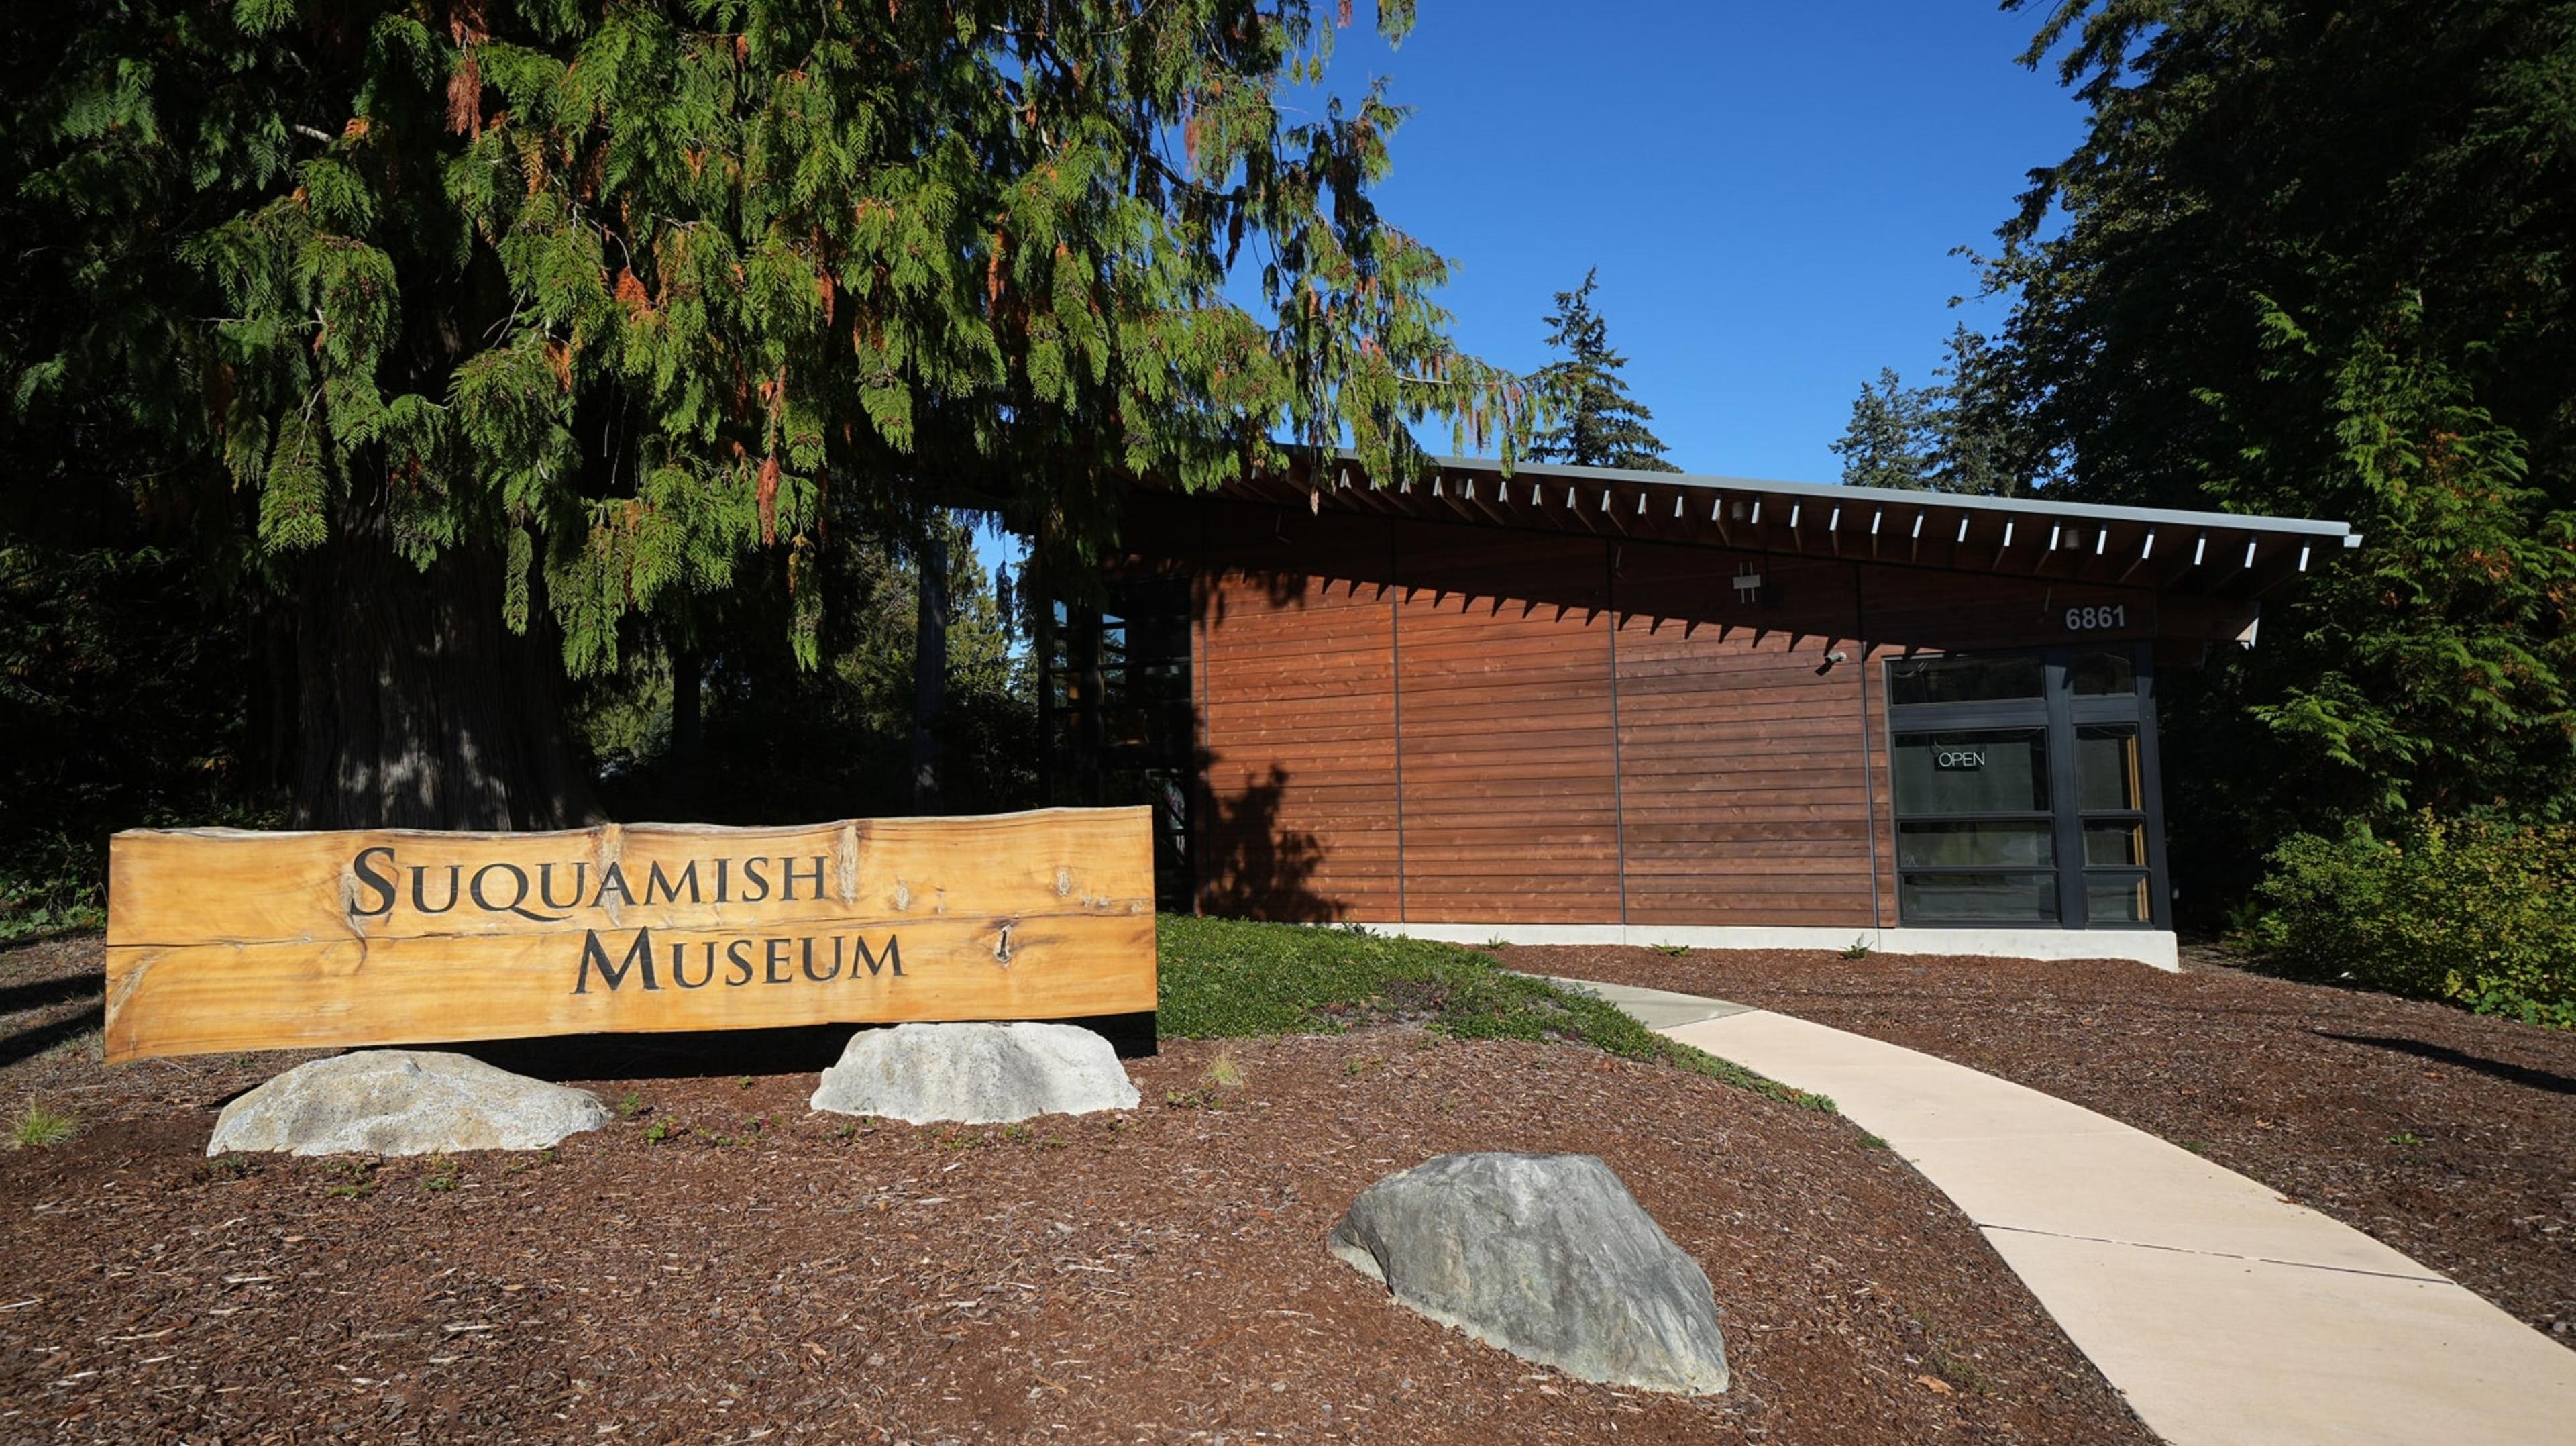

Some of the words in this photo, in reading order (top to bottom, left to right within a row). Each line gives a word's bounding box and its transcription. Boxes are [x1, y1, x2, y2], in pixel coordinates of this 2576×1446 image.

[2065, 605, 2125, 630] 6861
[1938, 752, 1985, 767] OPEN
[349, 847, 830, 922] SUQUAMISH
[569, 926, 908, 995] MUSEUM
